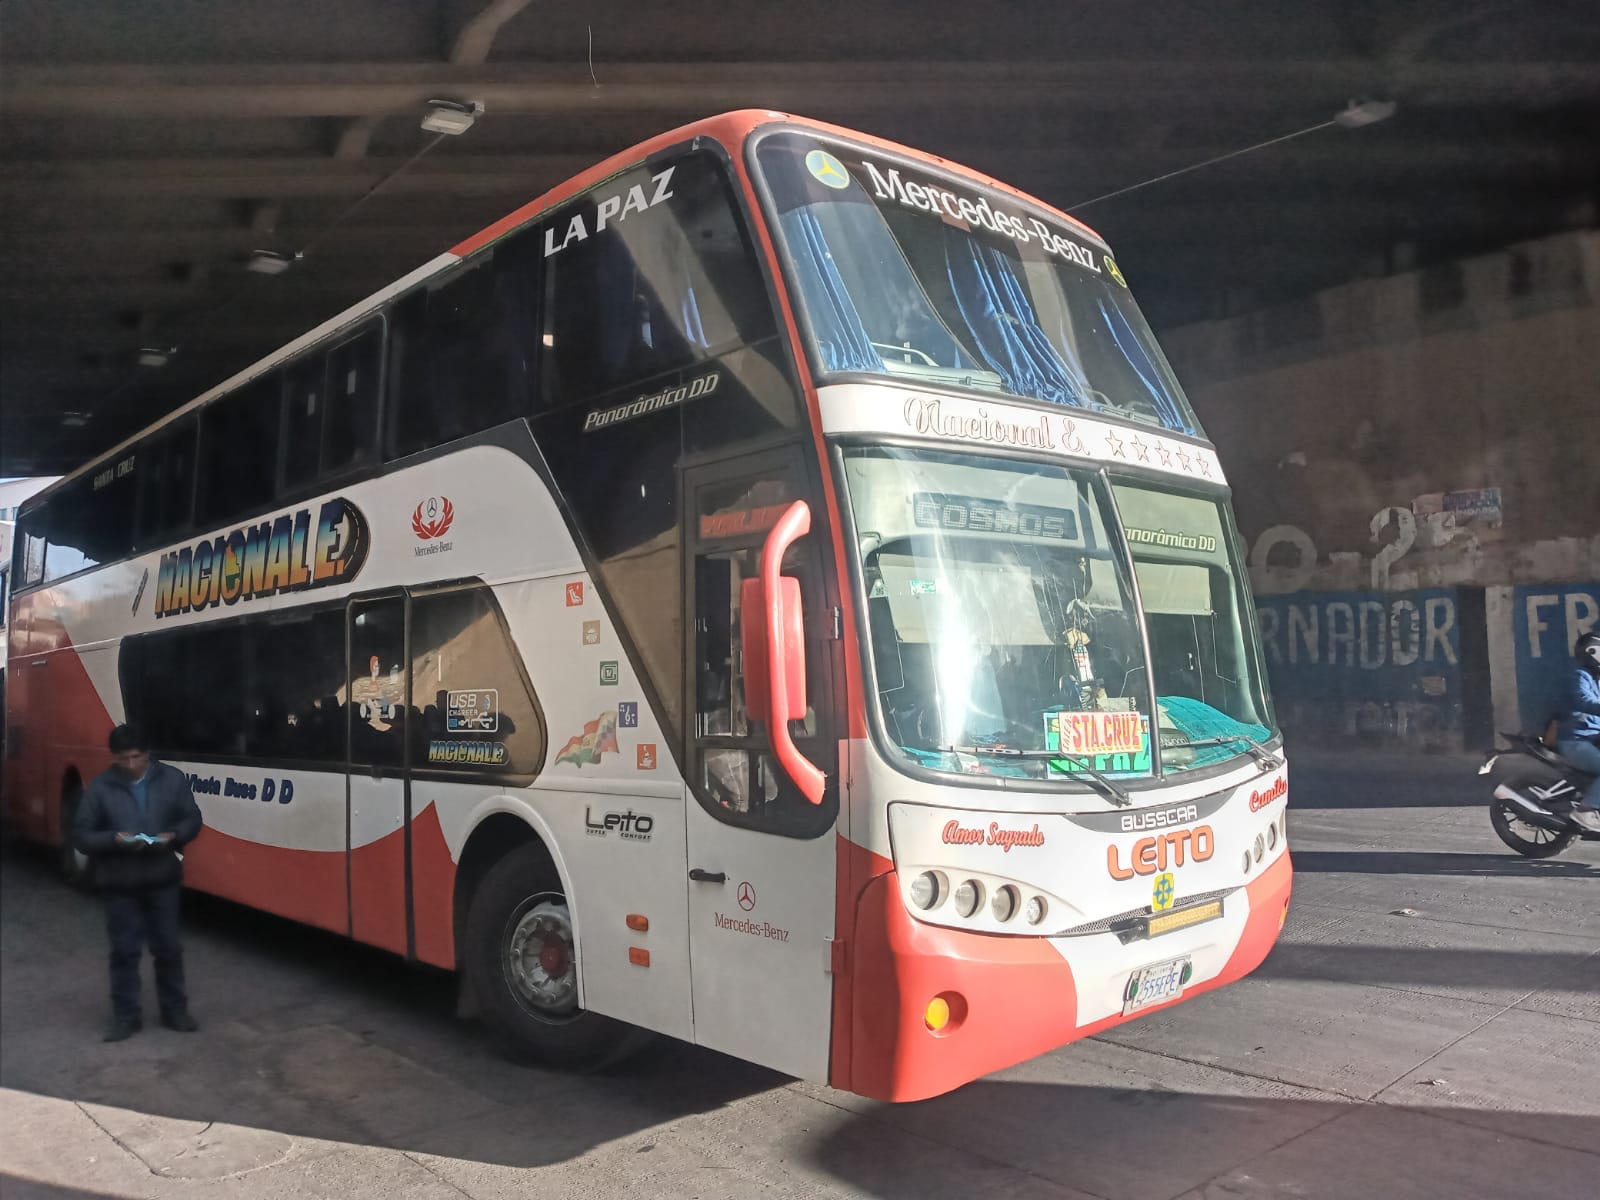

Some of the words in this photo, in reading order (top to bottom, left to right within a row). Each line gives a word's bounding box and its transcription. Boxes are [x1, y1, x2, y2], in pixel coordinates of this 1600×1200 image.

[544, 214, 588, 257] LA
[596, 165, 676, 233] PAZ
[862, 161, 1102, 273] Mercedes-Benz
[584, 388, 685, 430] Panorâmico
[688, 373, 720, 400] DD
[903, 397, 1055, 449] Nacional
[915, 500, 1066, 539] COSMOS
[414, 541, 454, 557] Mercedes-Benz
[1198, 534, 1217, 552] DD
[449, 693, 477, 709] USB
[586, 807, 653, 833] Leito
[1121, 805, 1198, 831] BUSSCAR
[941, 819, 985, 845] Amor
[986, 821, 1045, 853] Sagrado
[1107, 825, 1215, 881] LEITO
[715, 911, 790, 942] Mercedes-Benz
